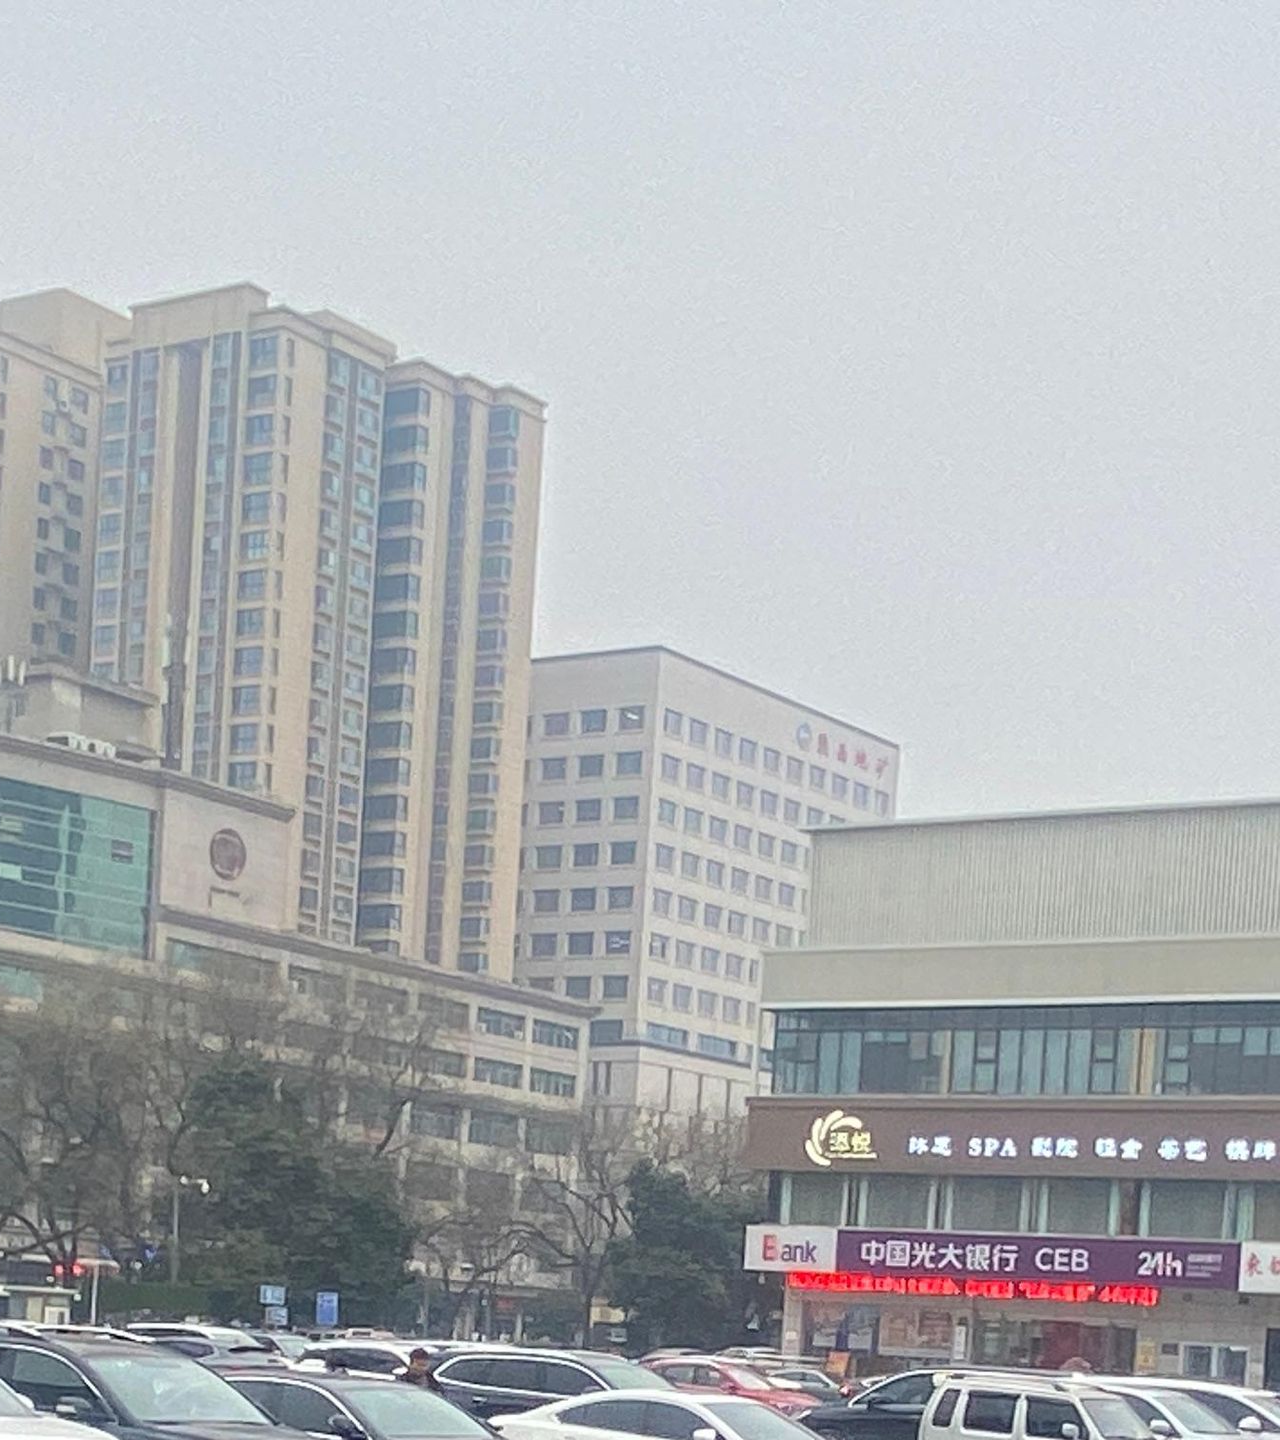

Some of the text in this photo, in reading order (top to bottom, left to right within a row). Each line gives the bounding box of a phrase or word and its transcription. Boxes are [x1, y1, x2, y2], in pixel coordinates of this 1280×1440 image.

[968, 1137, 1017, 1157] SPA
[860, 1239, 1019, 1272] 中国光大银行
[1034, 1247, 1090, 1273] CEB
[1137, 1251, 1183, 1277] 24h
